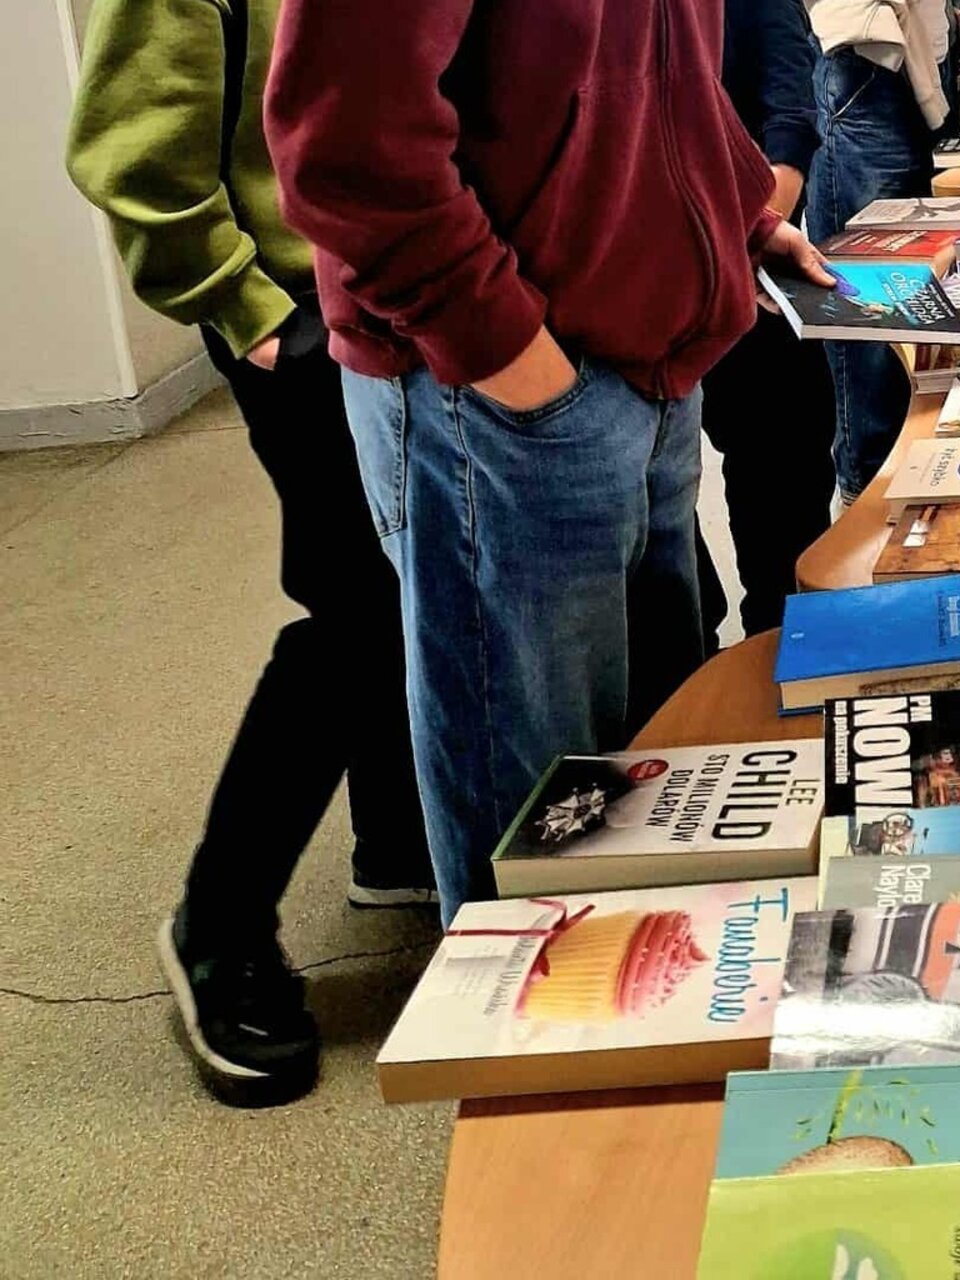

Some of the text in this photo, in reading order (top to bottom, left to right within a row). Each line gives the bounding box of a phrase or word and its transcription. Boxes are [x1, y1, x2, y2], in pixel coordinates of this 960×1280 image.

[910, 695, 932, 722] PM
[645, 769, 695, 827] DOLARÓW
[669, 754, 730, 842] STO MILIONÓW
[711, 750, 798, 840] CHILD
[785, 779, 821, 806] LEE
[903, 864, 931, 904] Clare
[707, 887, 789, 1022] Fanaberie
